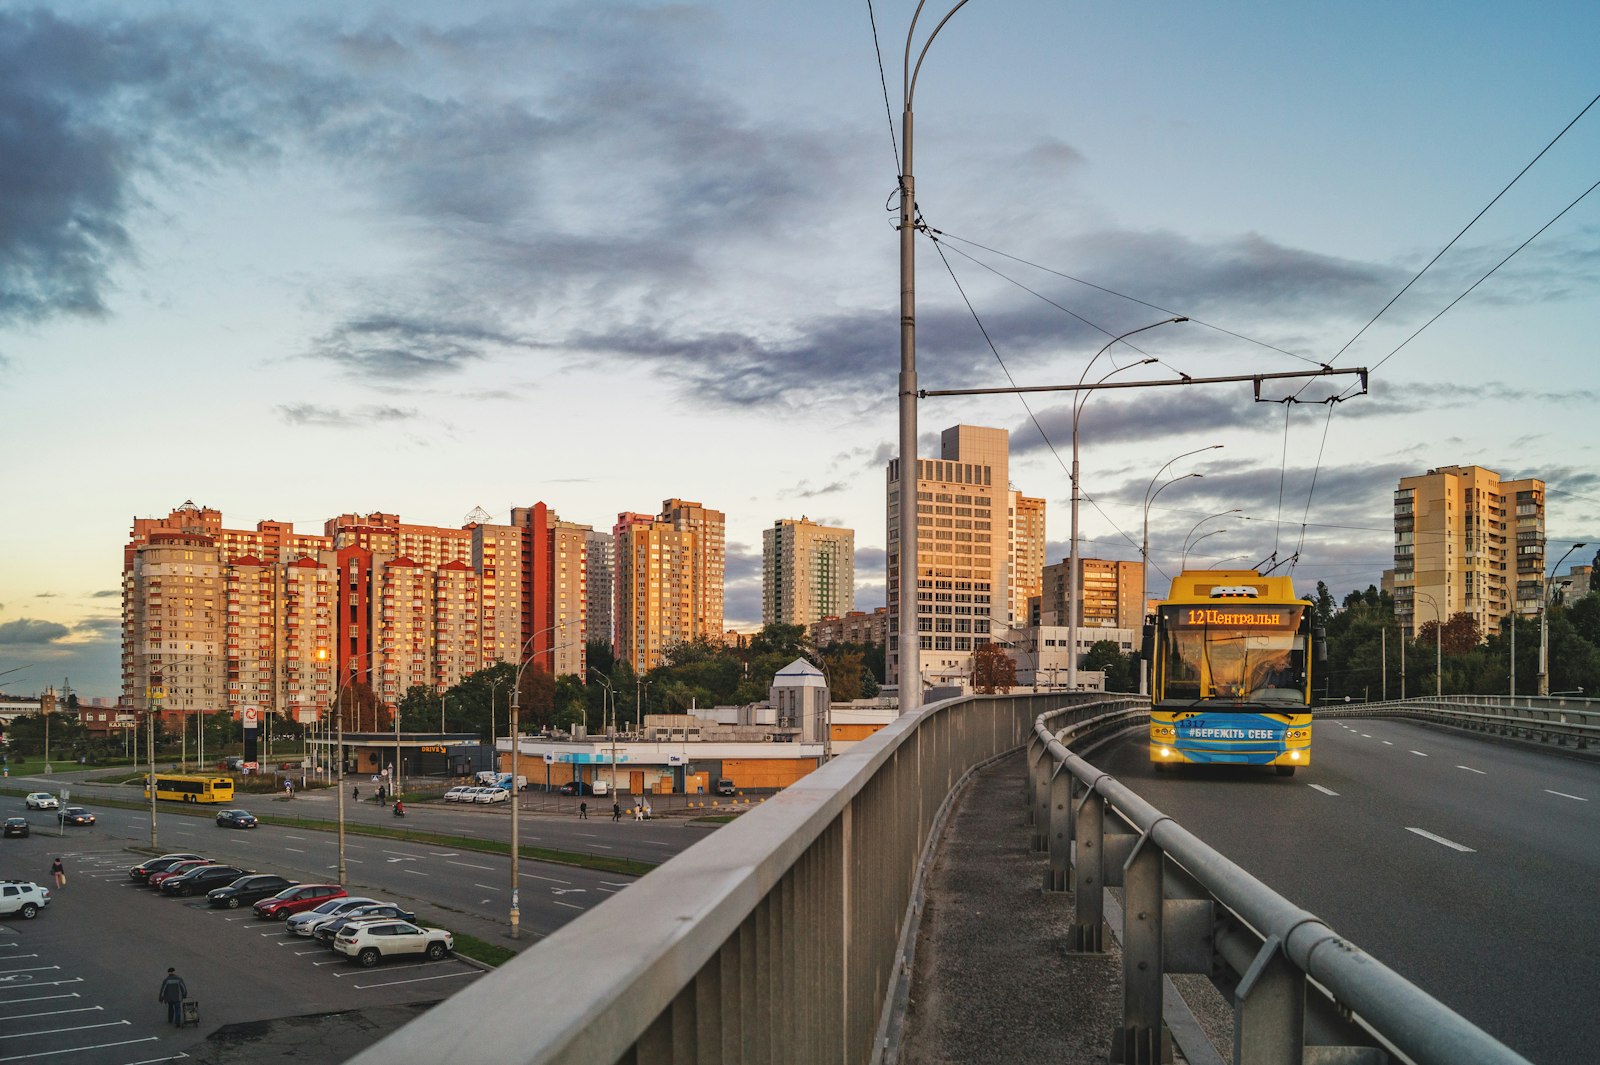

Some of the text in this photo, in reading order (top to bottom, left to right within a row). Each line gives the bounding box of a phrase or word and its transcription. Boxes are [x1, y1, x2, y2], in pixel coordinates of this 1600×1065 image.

[1188, 609, 1280, 625] 12 Центральн
[1180, 719, 1206, 728] 1317
[1189, 728, 1274, 739] #БЕРЕЖІТЬ СЕБЕ
